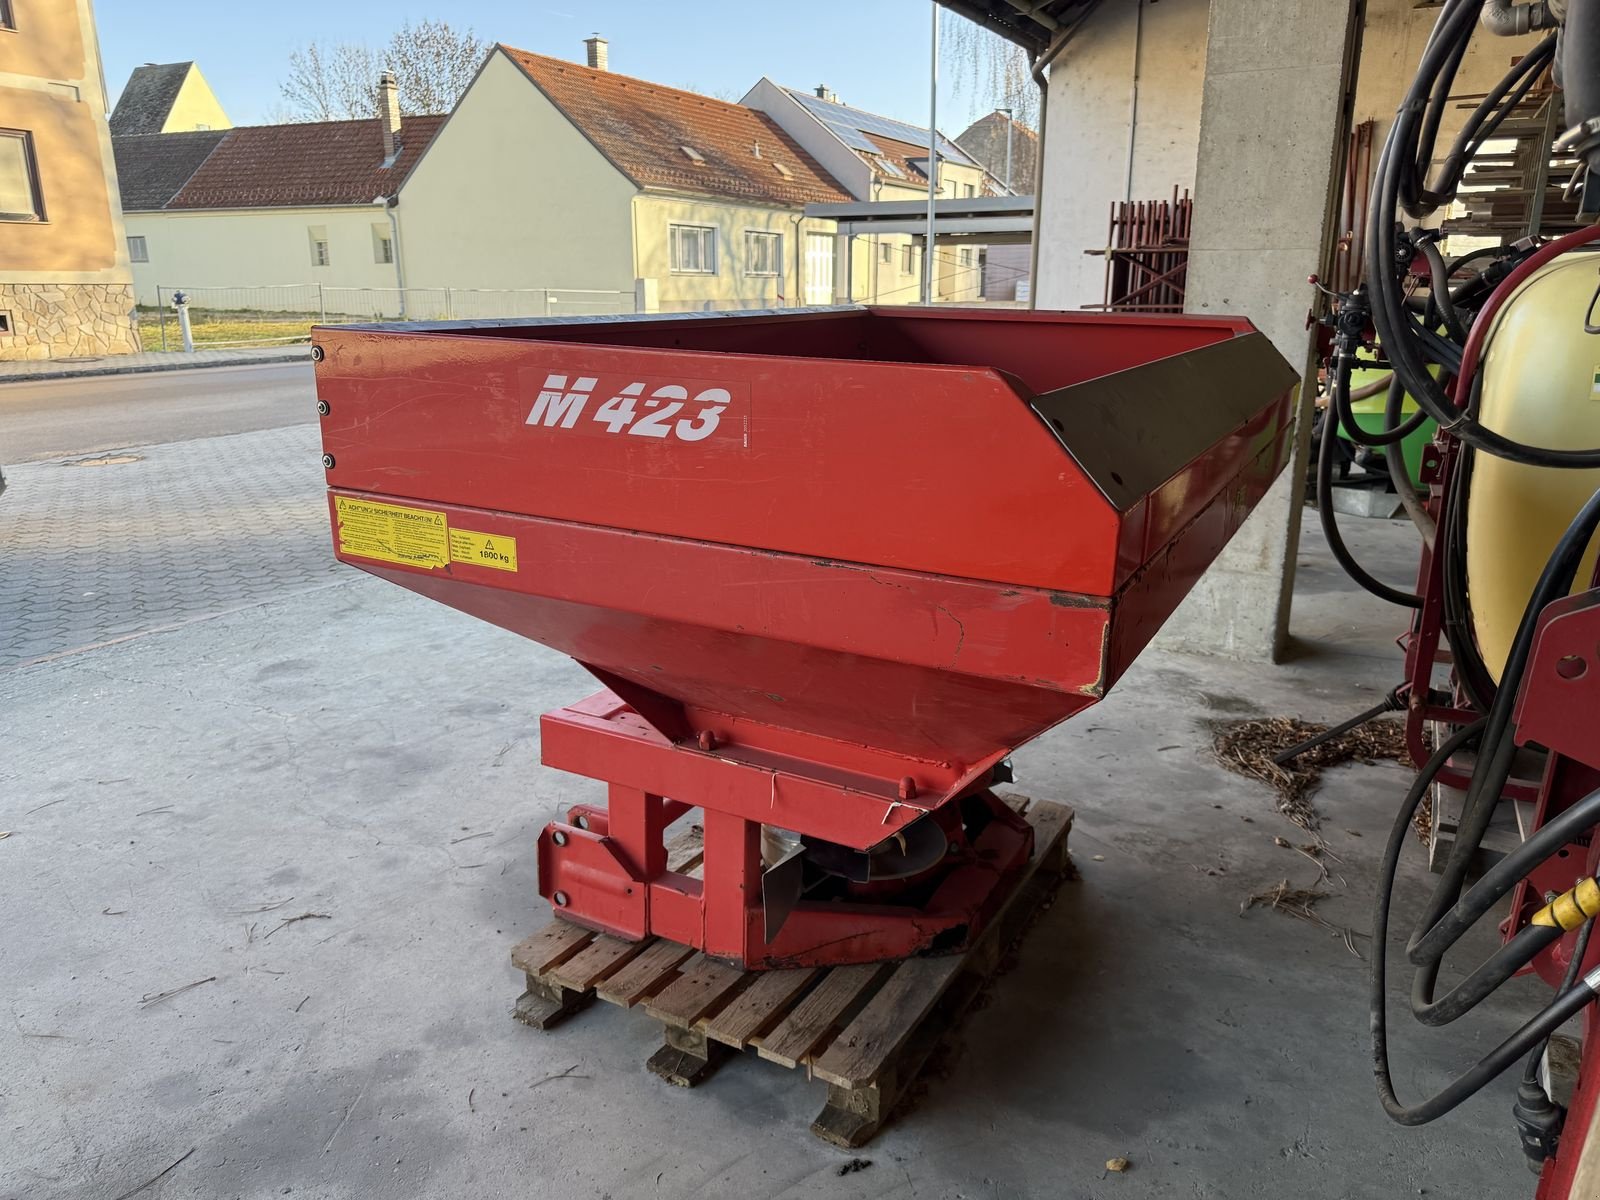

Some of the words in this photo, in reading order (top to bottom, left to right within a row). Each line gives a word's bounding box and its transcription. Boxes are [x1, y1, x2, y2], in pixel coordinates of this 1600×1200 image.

[525, 374, 599, 429] M
[593, 382, 731, 441] 423
[480, 550, 498, 560] 1800
[499, 553, 509, 563] kg
